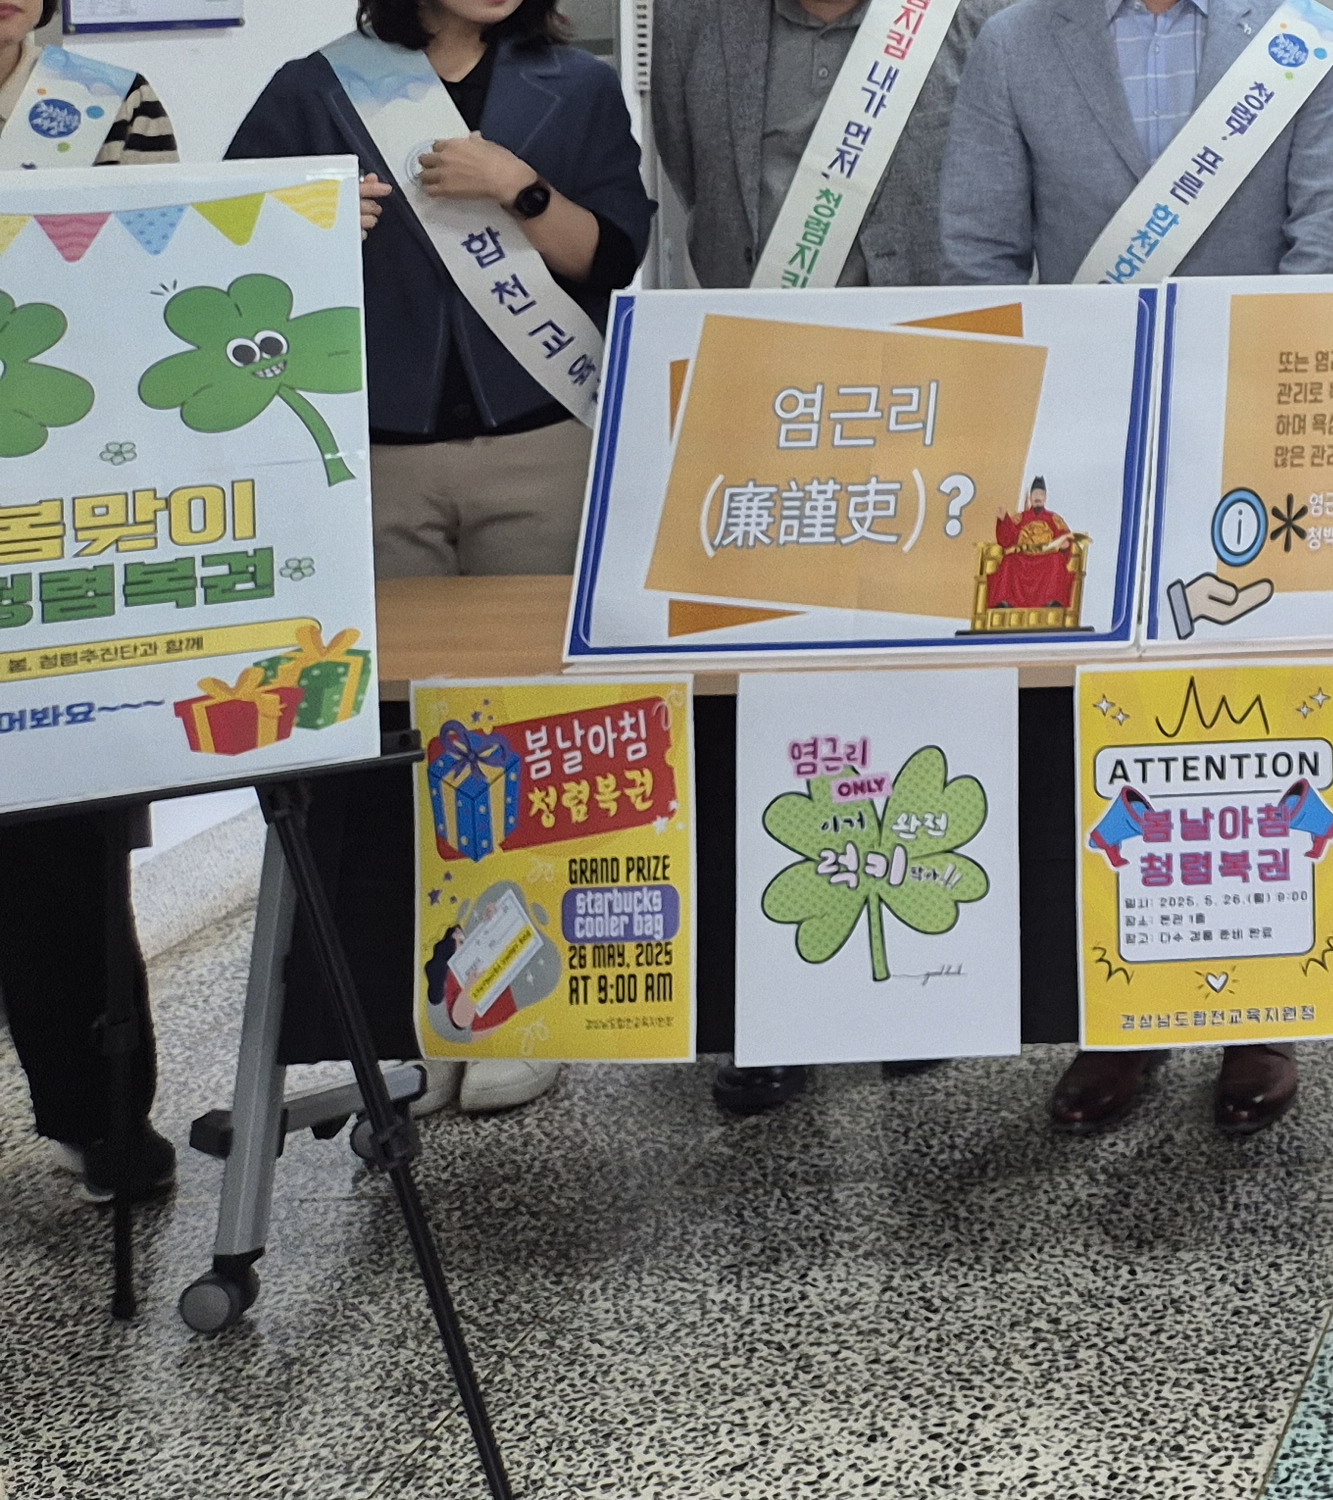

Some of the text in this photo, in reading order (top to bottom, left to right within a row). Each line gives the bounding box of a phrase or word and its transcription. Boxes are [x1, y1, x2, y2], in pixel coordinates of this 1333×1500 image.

[861, 60, 900, 119] 내가
[1169, 145, 1225, 206] 푸른
[1278, 350, 1310, 374] 또는
[1276, 380, 1324, 405] 관리로
[772, 378, 941, 451] 염근리
[1275, 413, 1307, 436] 하며
[1273, 444, 1306, 469] 많은
[39, 641, 158, 670] 청렴추진단과
[164, 636, 204, 655] 함께
[524, 708, 648, 782] 봄날아침
[790, 736, 871, 777] 염근리
[1108, 750, 1321, 786] ATTENTION
[527, 767, 655, 829] 청렴복권
[836, 776, 886, 798] ONLY
[891, 812, 949, 840] 완전
[1141, 803, 1291, 844] 봄날아침
[568, 854, 671, 885] GRAND PRIZE
[816, 840, 908, 891] 럭키
[1139, 847, 1291, 887] 청렴복권
[575, 886, 663, 915] starbucks
[574, 910, 664, 941] cooler bag
[568, 944, 587, 970] 26
[635, 941, 673, 967] 2025
[568, 972, 673, 1005] AT 9:00 AM
[1120, 1004, 1316, 1031] 경상남도합천교육지원청
